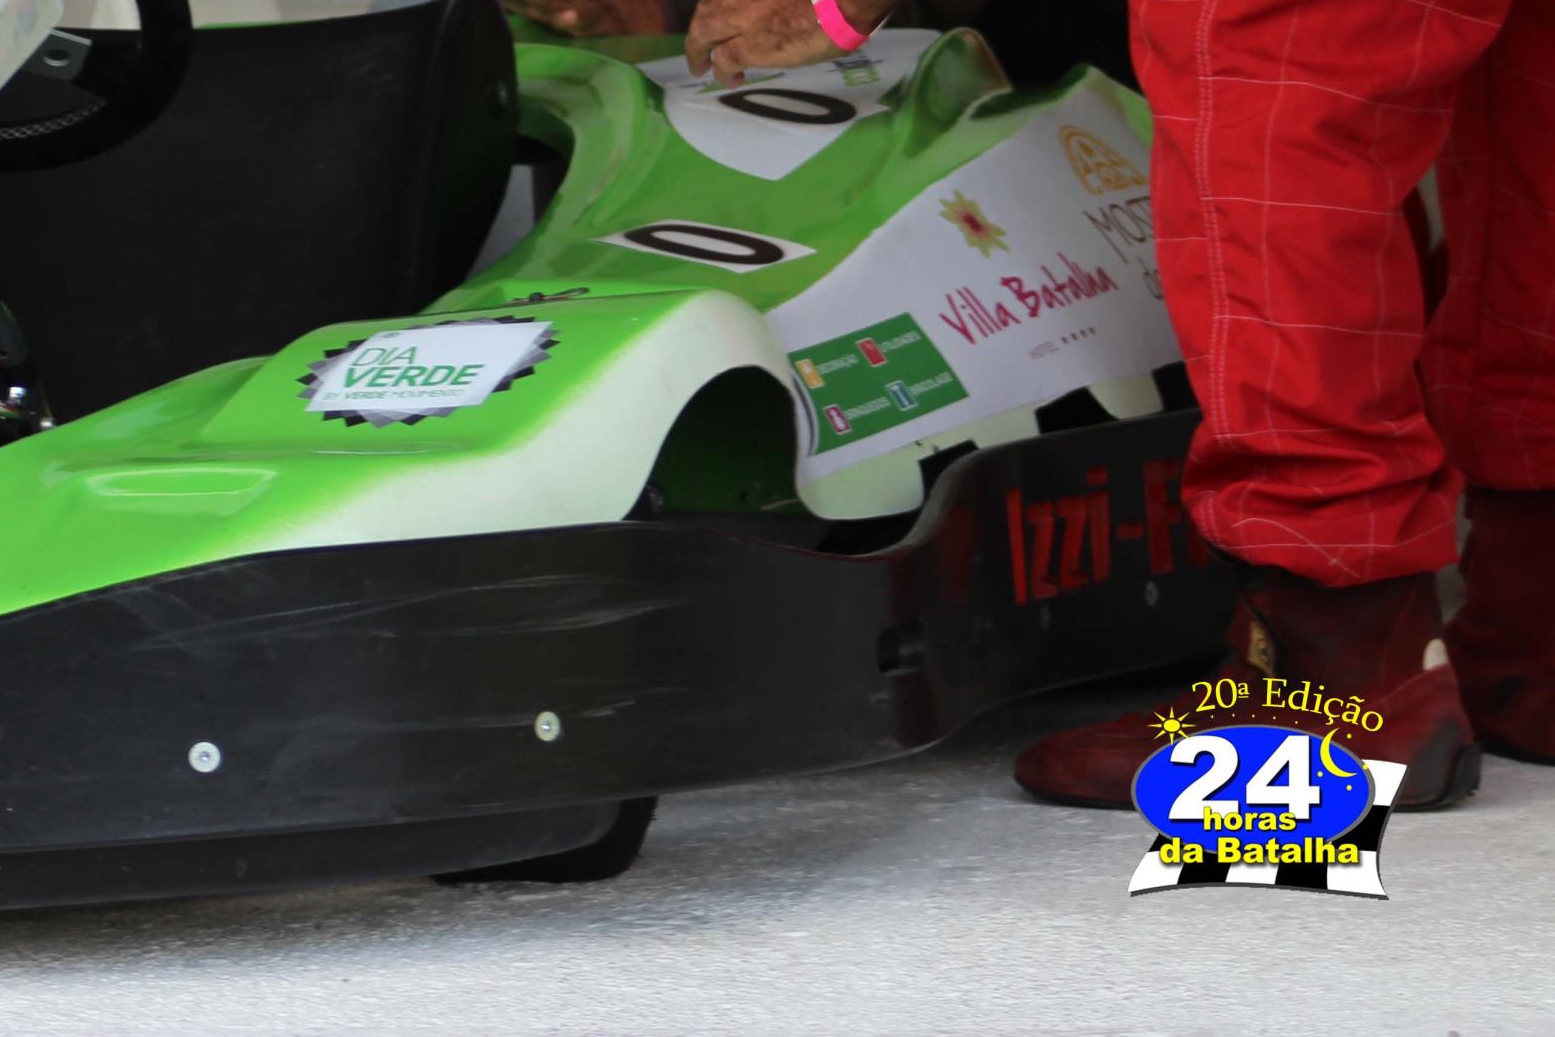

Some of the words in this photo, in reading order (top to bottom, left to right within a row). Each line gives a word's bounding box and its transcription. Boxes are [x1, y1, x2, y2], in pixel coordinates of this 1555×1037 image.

[623, 224, 784, 266] 0
[938, 286, 1022, 346] Villa
[1000, 252, 1120, 319] Batalha
[350, 346, 419, 366] DIA
[342, 363, 487, 388] VERDE
